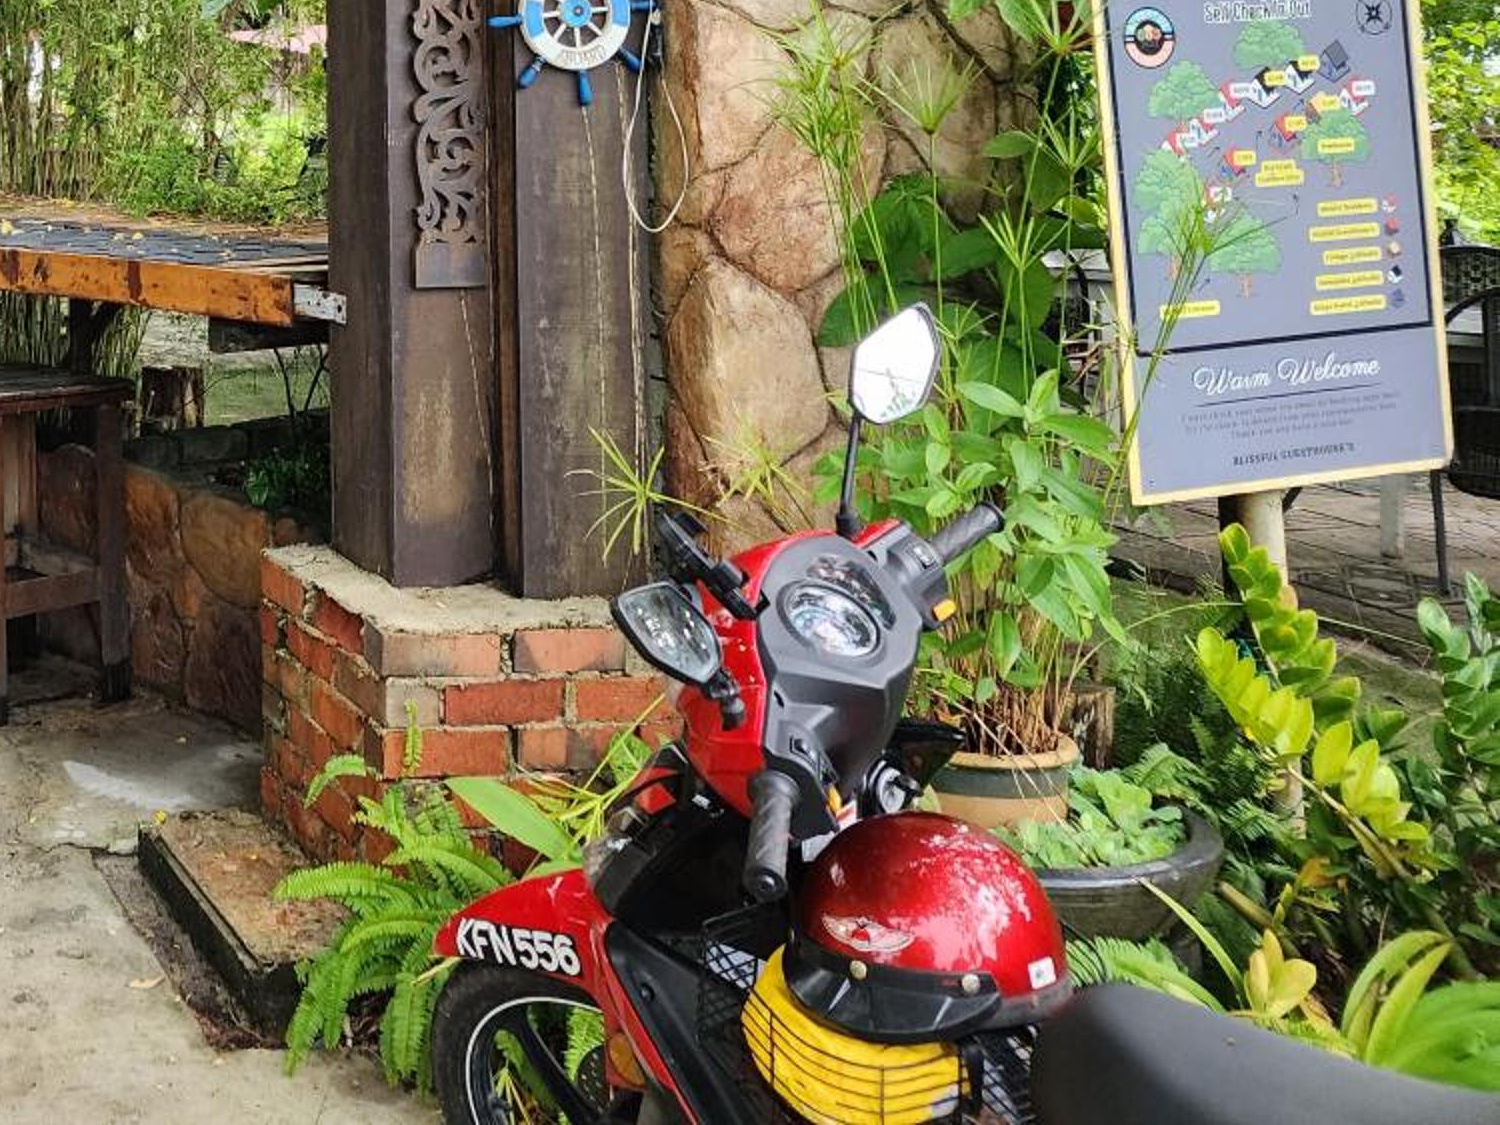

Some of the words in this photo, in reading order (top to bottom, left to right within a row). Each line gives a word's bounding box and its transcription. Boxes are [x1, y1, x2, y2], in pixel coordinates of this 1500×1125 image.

[1204, 1, 1231, 24] Self
[1192, 365, 1271, 396] Warm
[1277, 350, 1381, 387] Welcome
